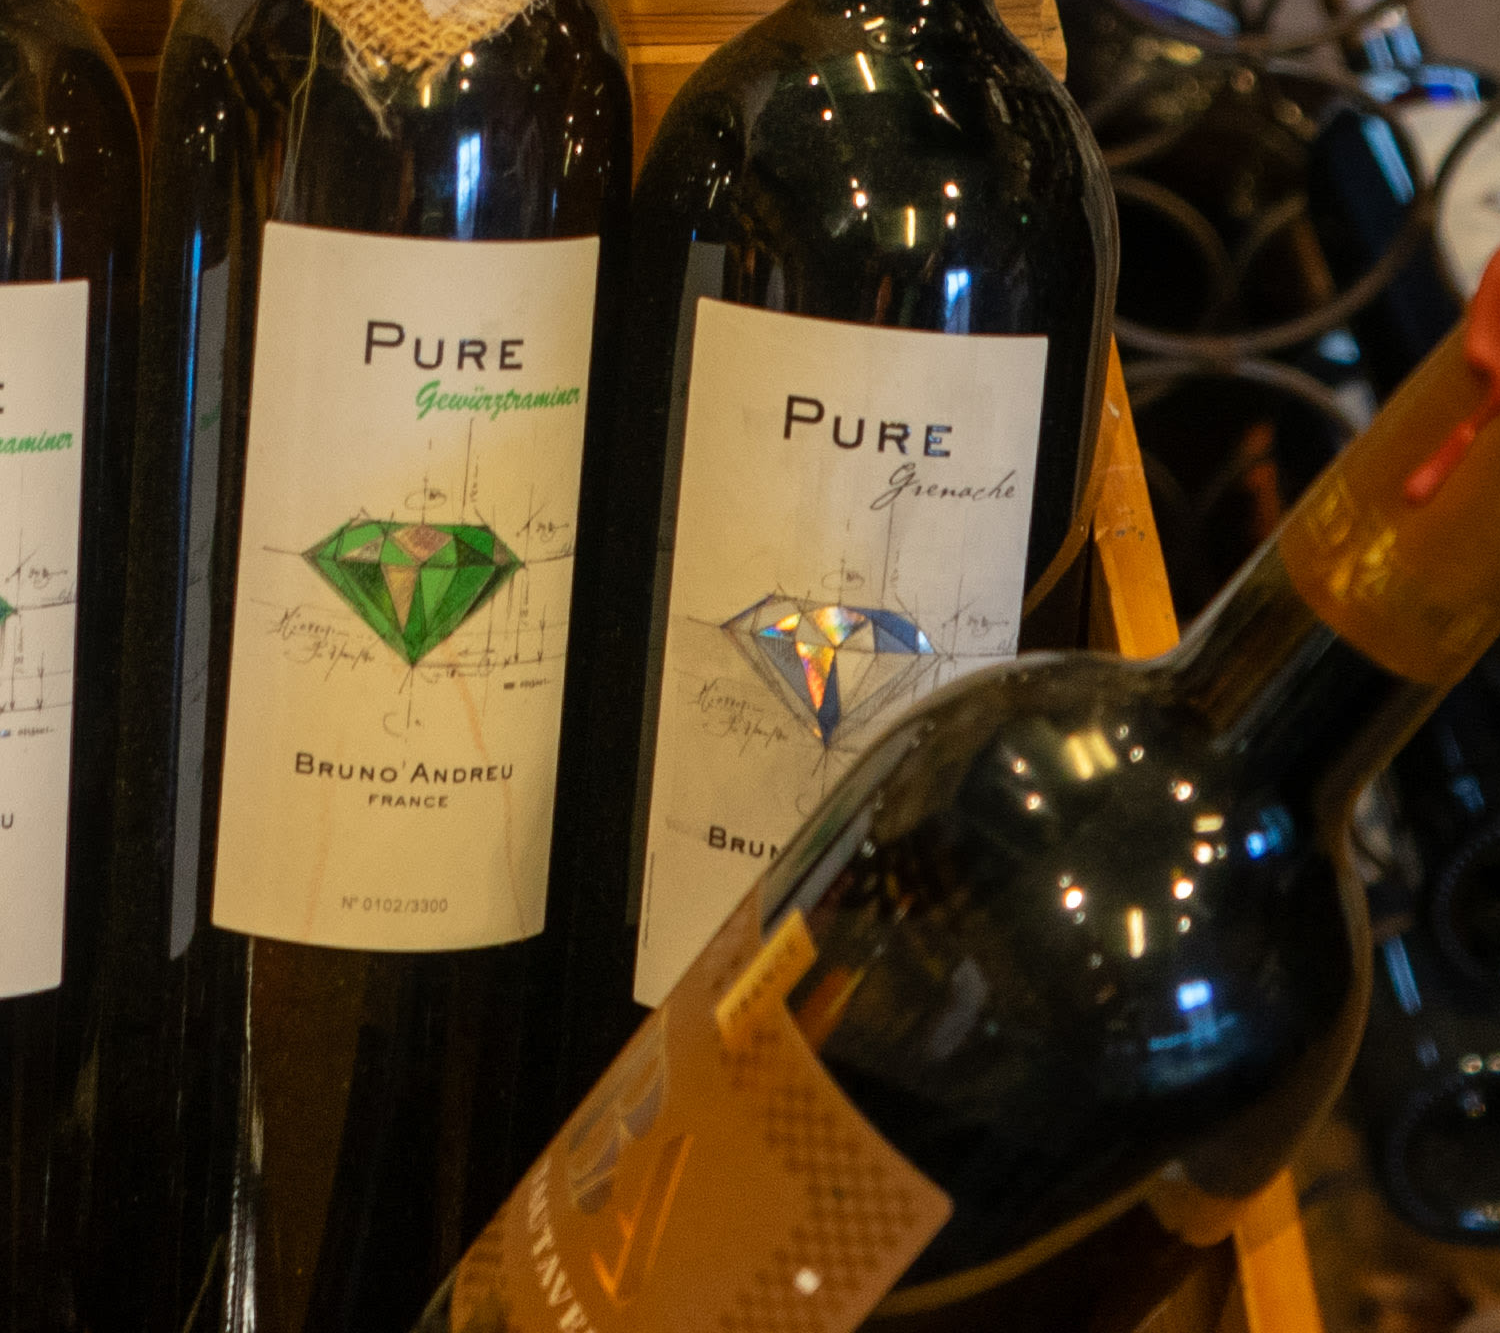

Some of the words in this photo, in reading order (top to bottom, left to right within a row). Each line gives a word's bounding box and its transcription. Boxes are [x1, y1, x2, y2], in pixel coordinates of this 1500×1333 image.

[363, 320, 525, 371] PURE
[414, 379, 581, 421] Gewürztraminer
[783, 394, 953, 458] PURE
[870, 462, 1016, 511] Grenache
[295, 752, 398, 783] BRUNO
[411, 763, 514, 784] ANDREU
[368, 793, 450, 809] FRANCE
[708, 825, 786, 861] BRUN
